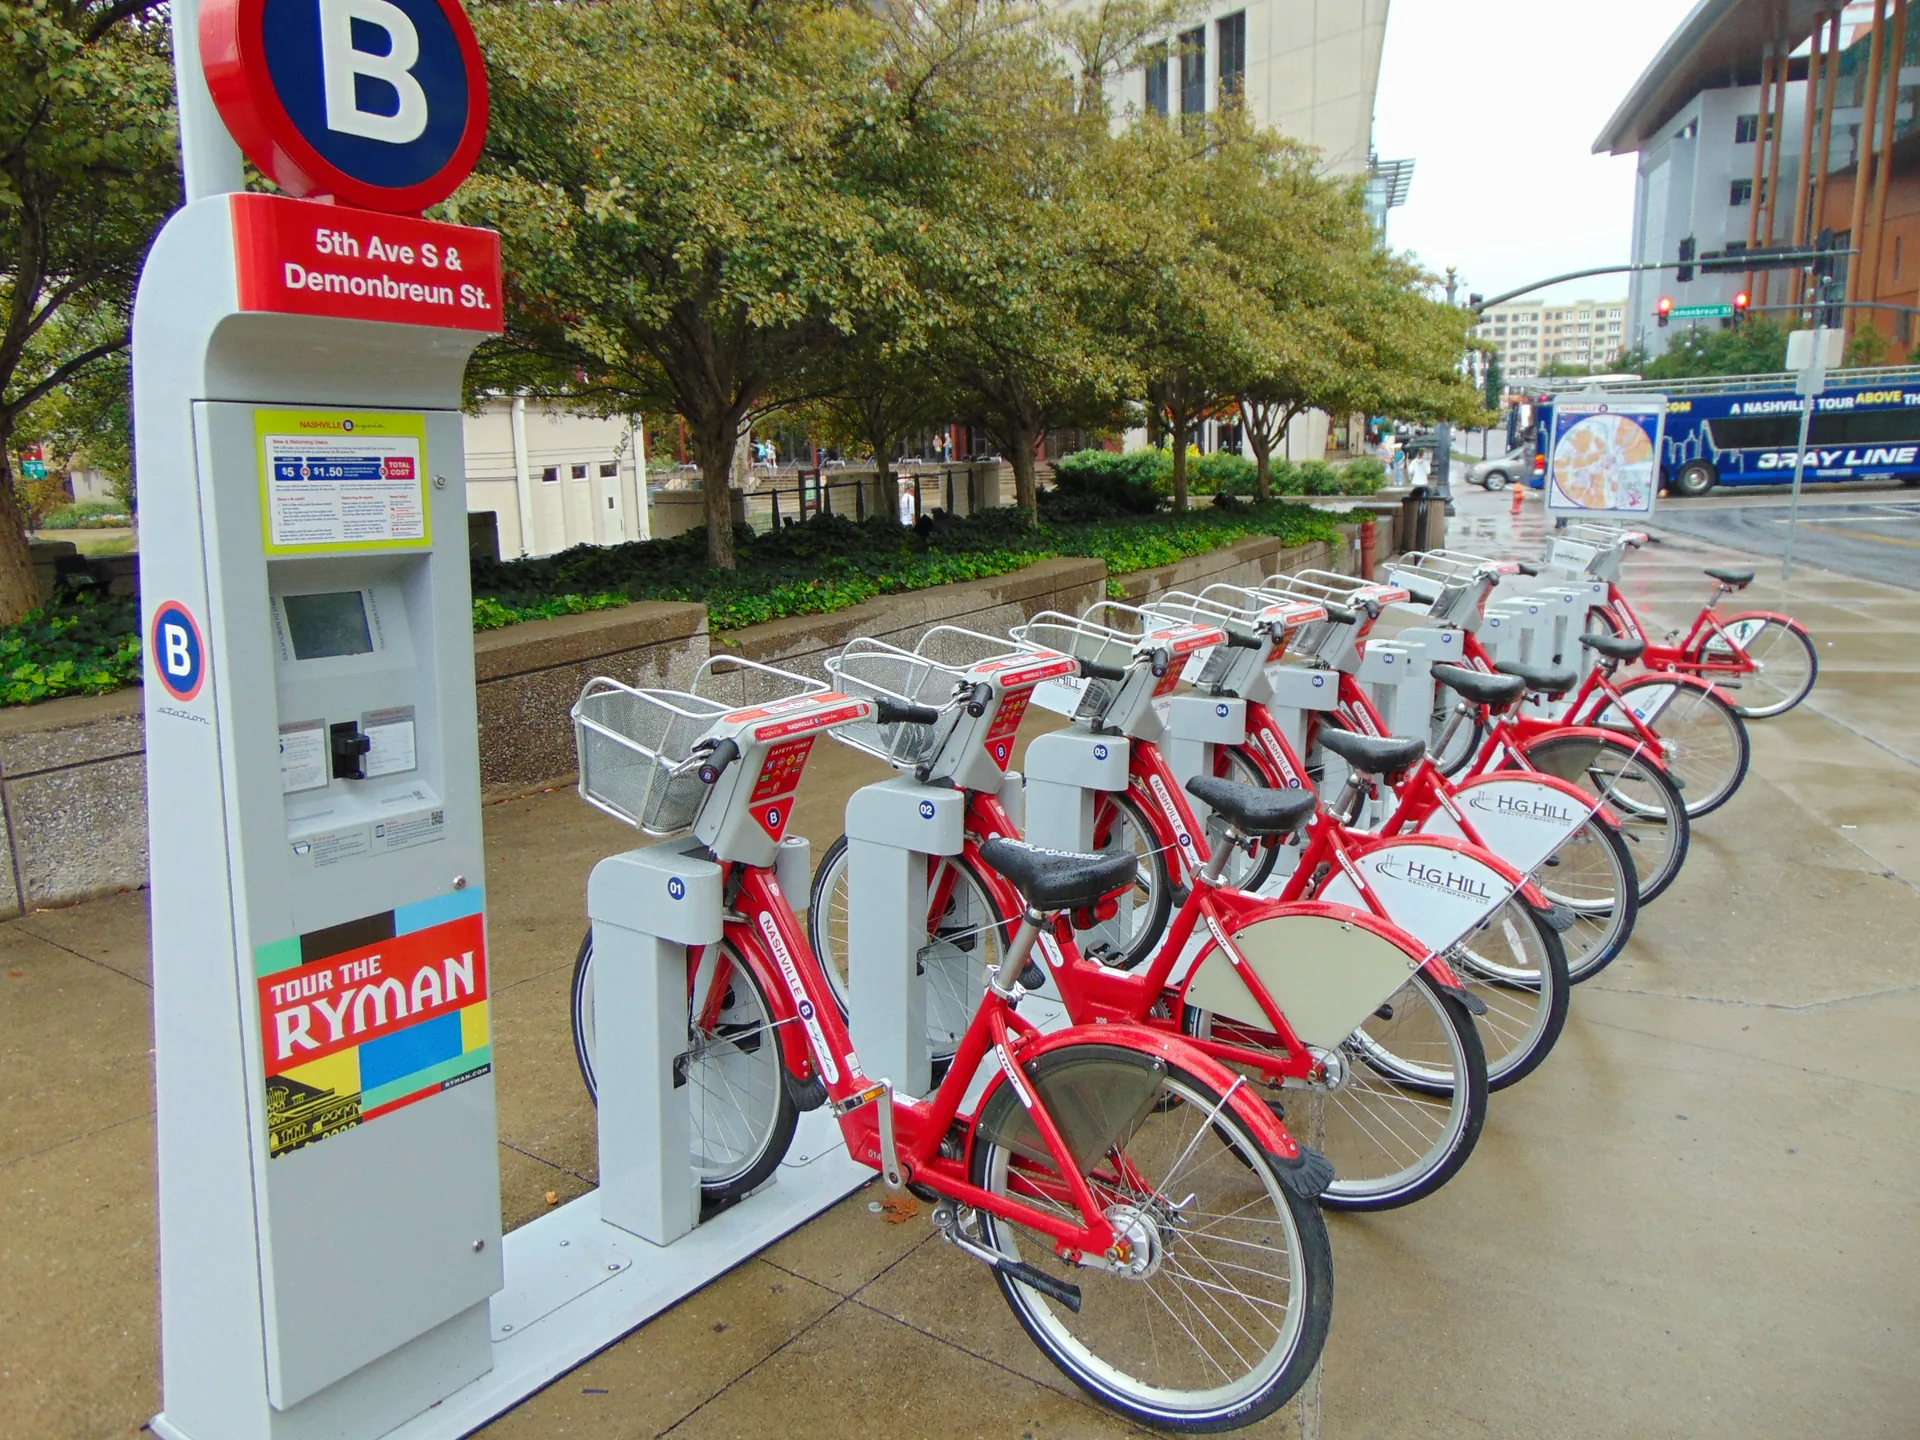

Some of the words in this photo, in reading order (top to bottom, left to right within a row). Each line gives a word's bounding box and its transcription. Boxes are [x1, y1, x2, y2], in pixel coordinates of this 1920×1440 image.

[319, 0, 428, 145] B
[316, 228, 359, 258] 5th
[367, 236, 414, 265] Ave
[421, 243, 438, 269] S
[445, 247, 462, 271] &
[284, 262, 453, 305] Demonbreun
[460, 283, 492, 310] St.
[1722, 306, 1731, 315] St
[1730, 402, 1741, 415] A
[1817, 397, 1855, 410] TOUR
[1855, 390, 1903, 404] ABOVE
[299, 420, 342, 429] NASHVILLE
[388, 461, 410, 469] TOTAL
[1844, 446, 1919, 466] LINE
[281, 466, 296, 478] $5
[313, 466, 343, 477] $1.50
[164, 623, 191, 677] B
[1312, 677, 1323, 685] 05
[156, 706, 211, 725] station
[1216, 706, 1228, 715] 04
[787, 719, 814, 731] NASHVILLE
[770, 746, 793, 757] SAFETY
[794, 740, 811, 751] FIRST
[1094, 747, 1106, 757] 03
[1263, 732, 1292, 777] NASHVILLE
[919, 803, 933, 816] 02
[1152, 779, 1183, 832] NASHVILLE
[769, 811, 778, 825] B
[670, 881, 681, 896] 01
[1407, 879, 1435, 891] REALTY
[1475, 898, 1489, 906] LLC
[763, 918, 803, 998] NASHVILLE
[270, 969, 335, 1006] TOUR
[339, 954, 383, 985] THE
[273, 950, 476, 1061] RYMAN
[444, 1066, 489, 1088] RYMAN.COM
